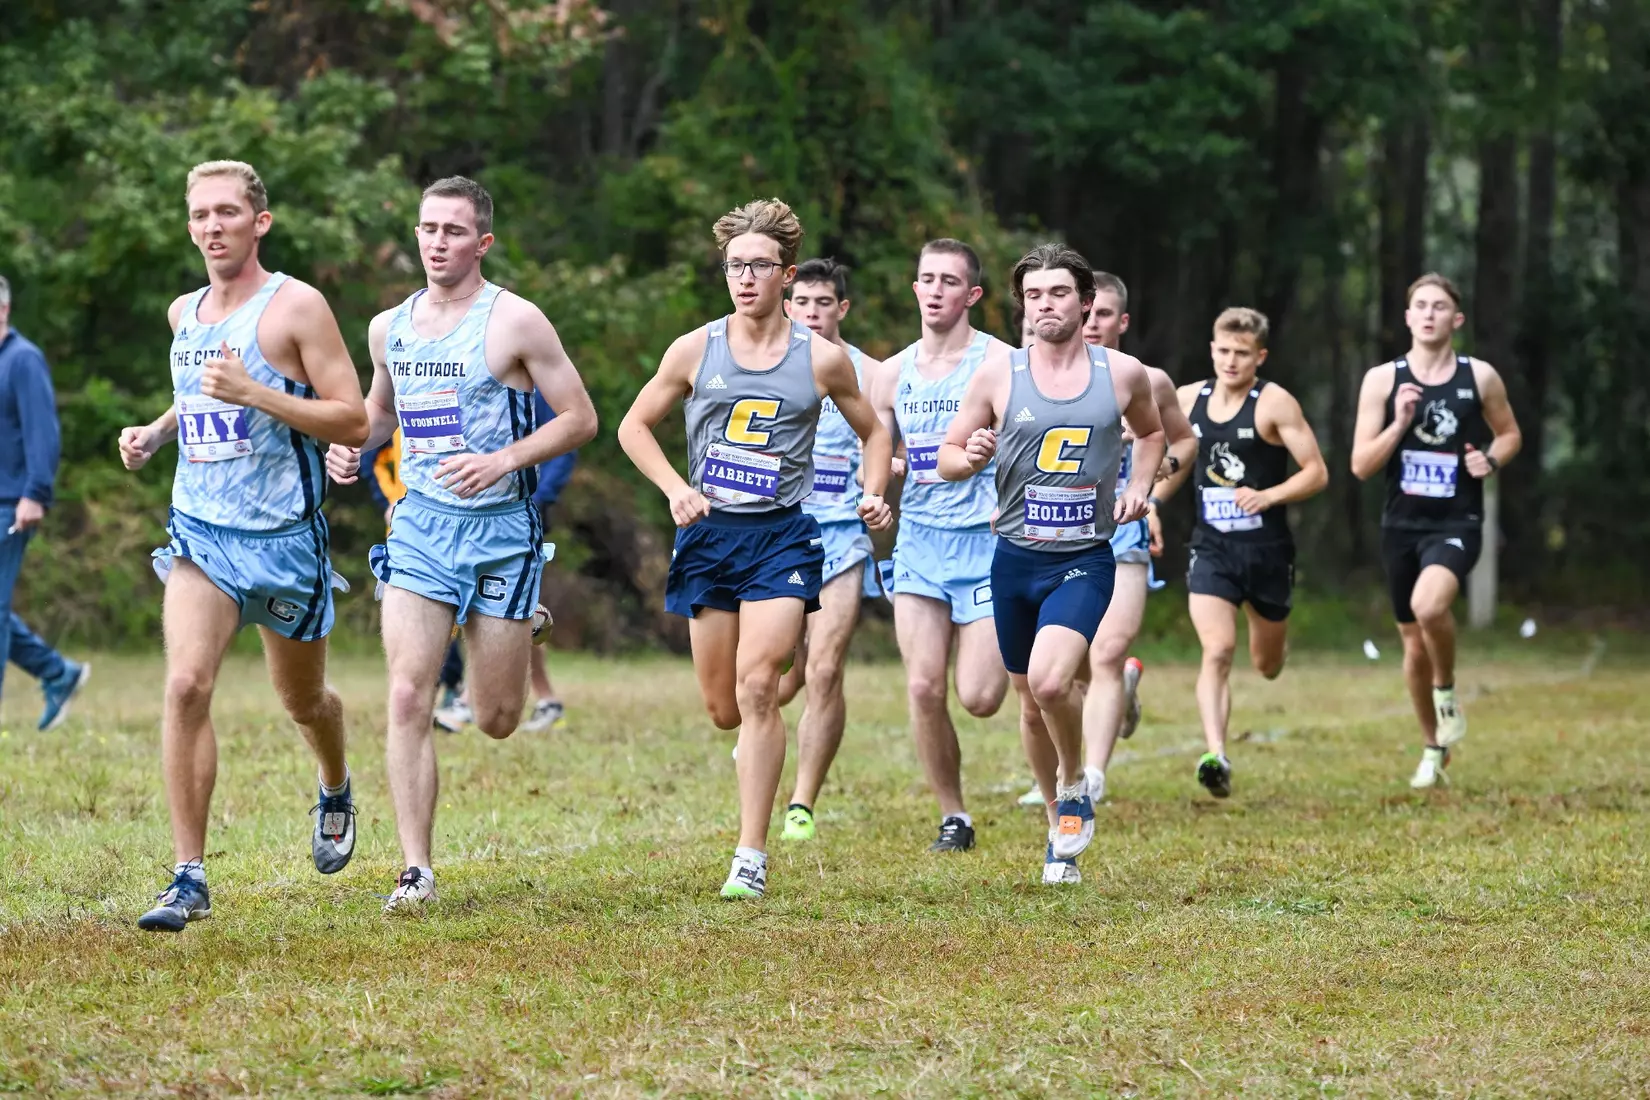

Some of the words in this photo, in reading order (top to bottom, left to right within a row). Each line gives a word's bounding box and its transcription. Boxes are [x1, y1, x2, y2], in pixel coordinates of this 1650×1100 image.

[174, 351, 190, 367] THE
[393, 362, 412, 376] THE
[415, 362, 466, 377] CITADEL
[903, 402, 919, 414] THE
[922, 400, 960, 413] CITADE
[183, 410, 241, 444] RAY
[410, 414, 459, 428] O'DONNELL
[723, 396, 784, 447] C
[1034, 425, 1094, 476] C
[707, 464, 776, 488] JARRETT
[1403, 464, 1456, 484] DALY
[1027, 503, 1094, 522] HOLLIS
[478, 574, 507, 602] C
